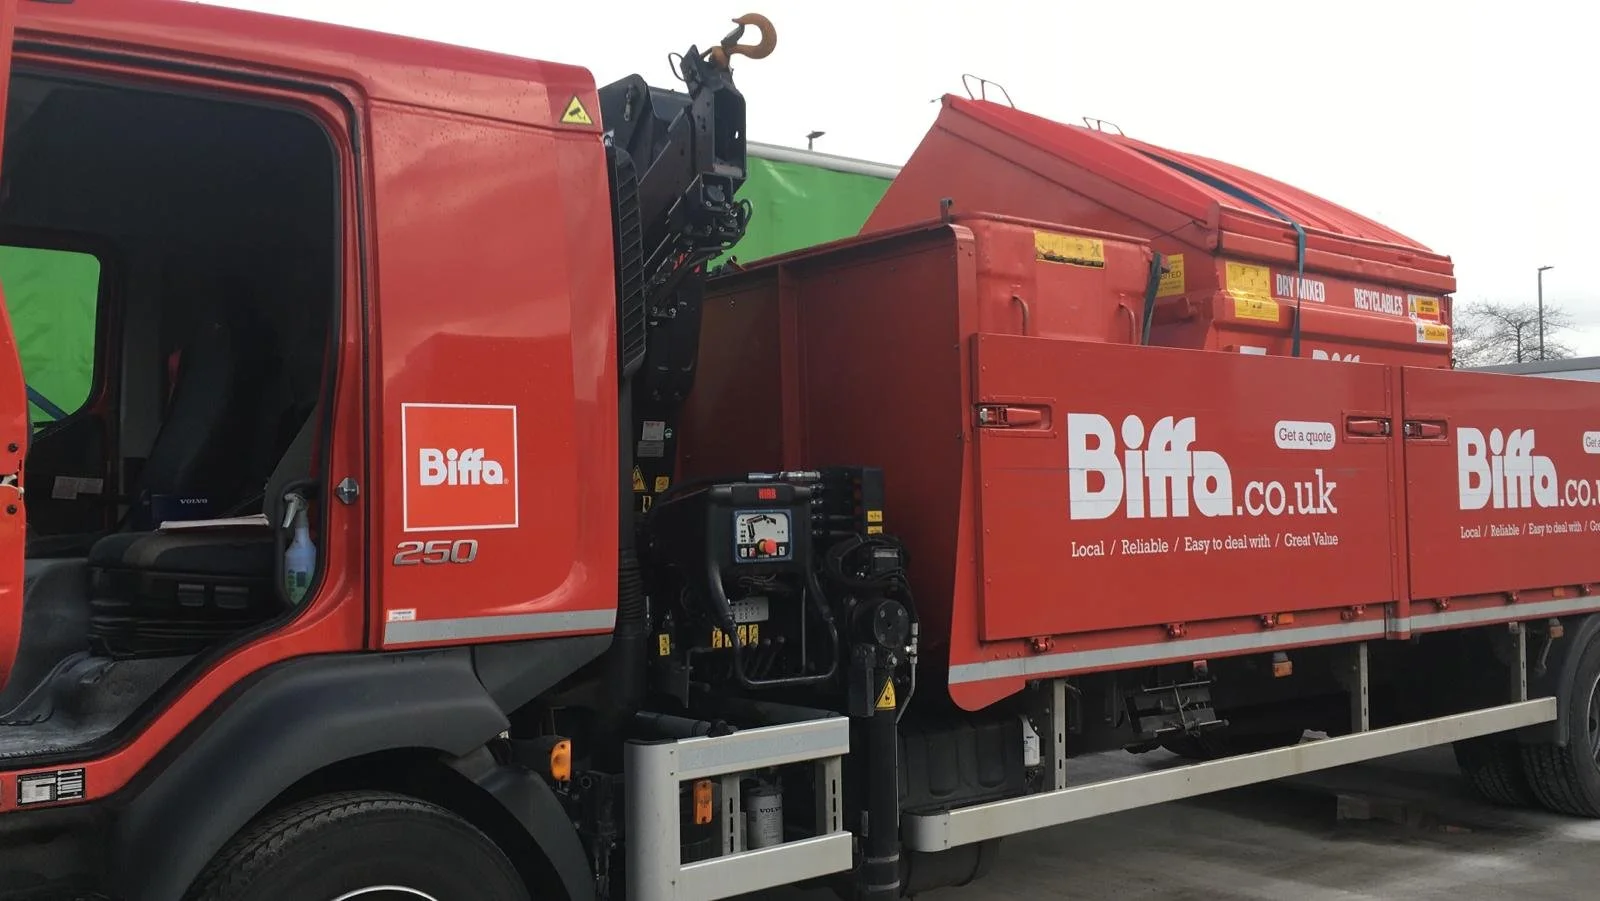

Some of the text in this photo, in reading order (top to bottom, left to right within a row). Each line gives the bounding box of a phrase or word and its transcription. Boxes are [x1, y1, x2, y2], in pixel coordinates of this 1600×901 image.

[1276, 274, 1294, 297] DRY
[1296, 278, 1325, 303] MIXED
[1354, 288, 1403, 316] RECYCLABLES
[1279, 427, 1332, 445] Get a quote
[1585, 436, 1597, 448] Get
[419, 448, 504, 486] Biffa
[1068, 413, 1338, 520] Biffa.co.uk
[1460, 526, 1481, 539] Local
[1491, 524, 1520, 537] Reliable
[1528, 522, 1545, 536] Easy
[1546, 523, 1553, 534] to
[1554, 521, 1568, 533] deal
[1568, 521, 1583, 533] with
[393, 539, 478, 565] 250
[1071, 531, 1339, 557] Local / Reliable / Easy to deal with / Great Value
